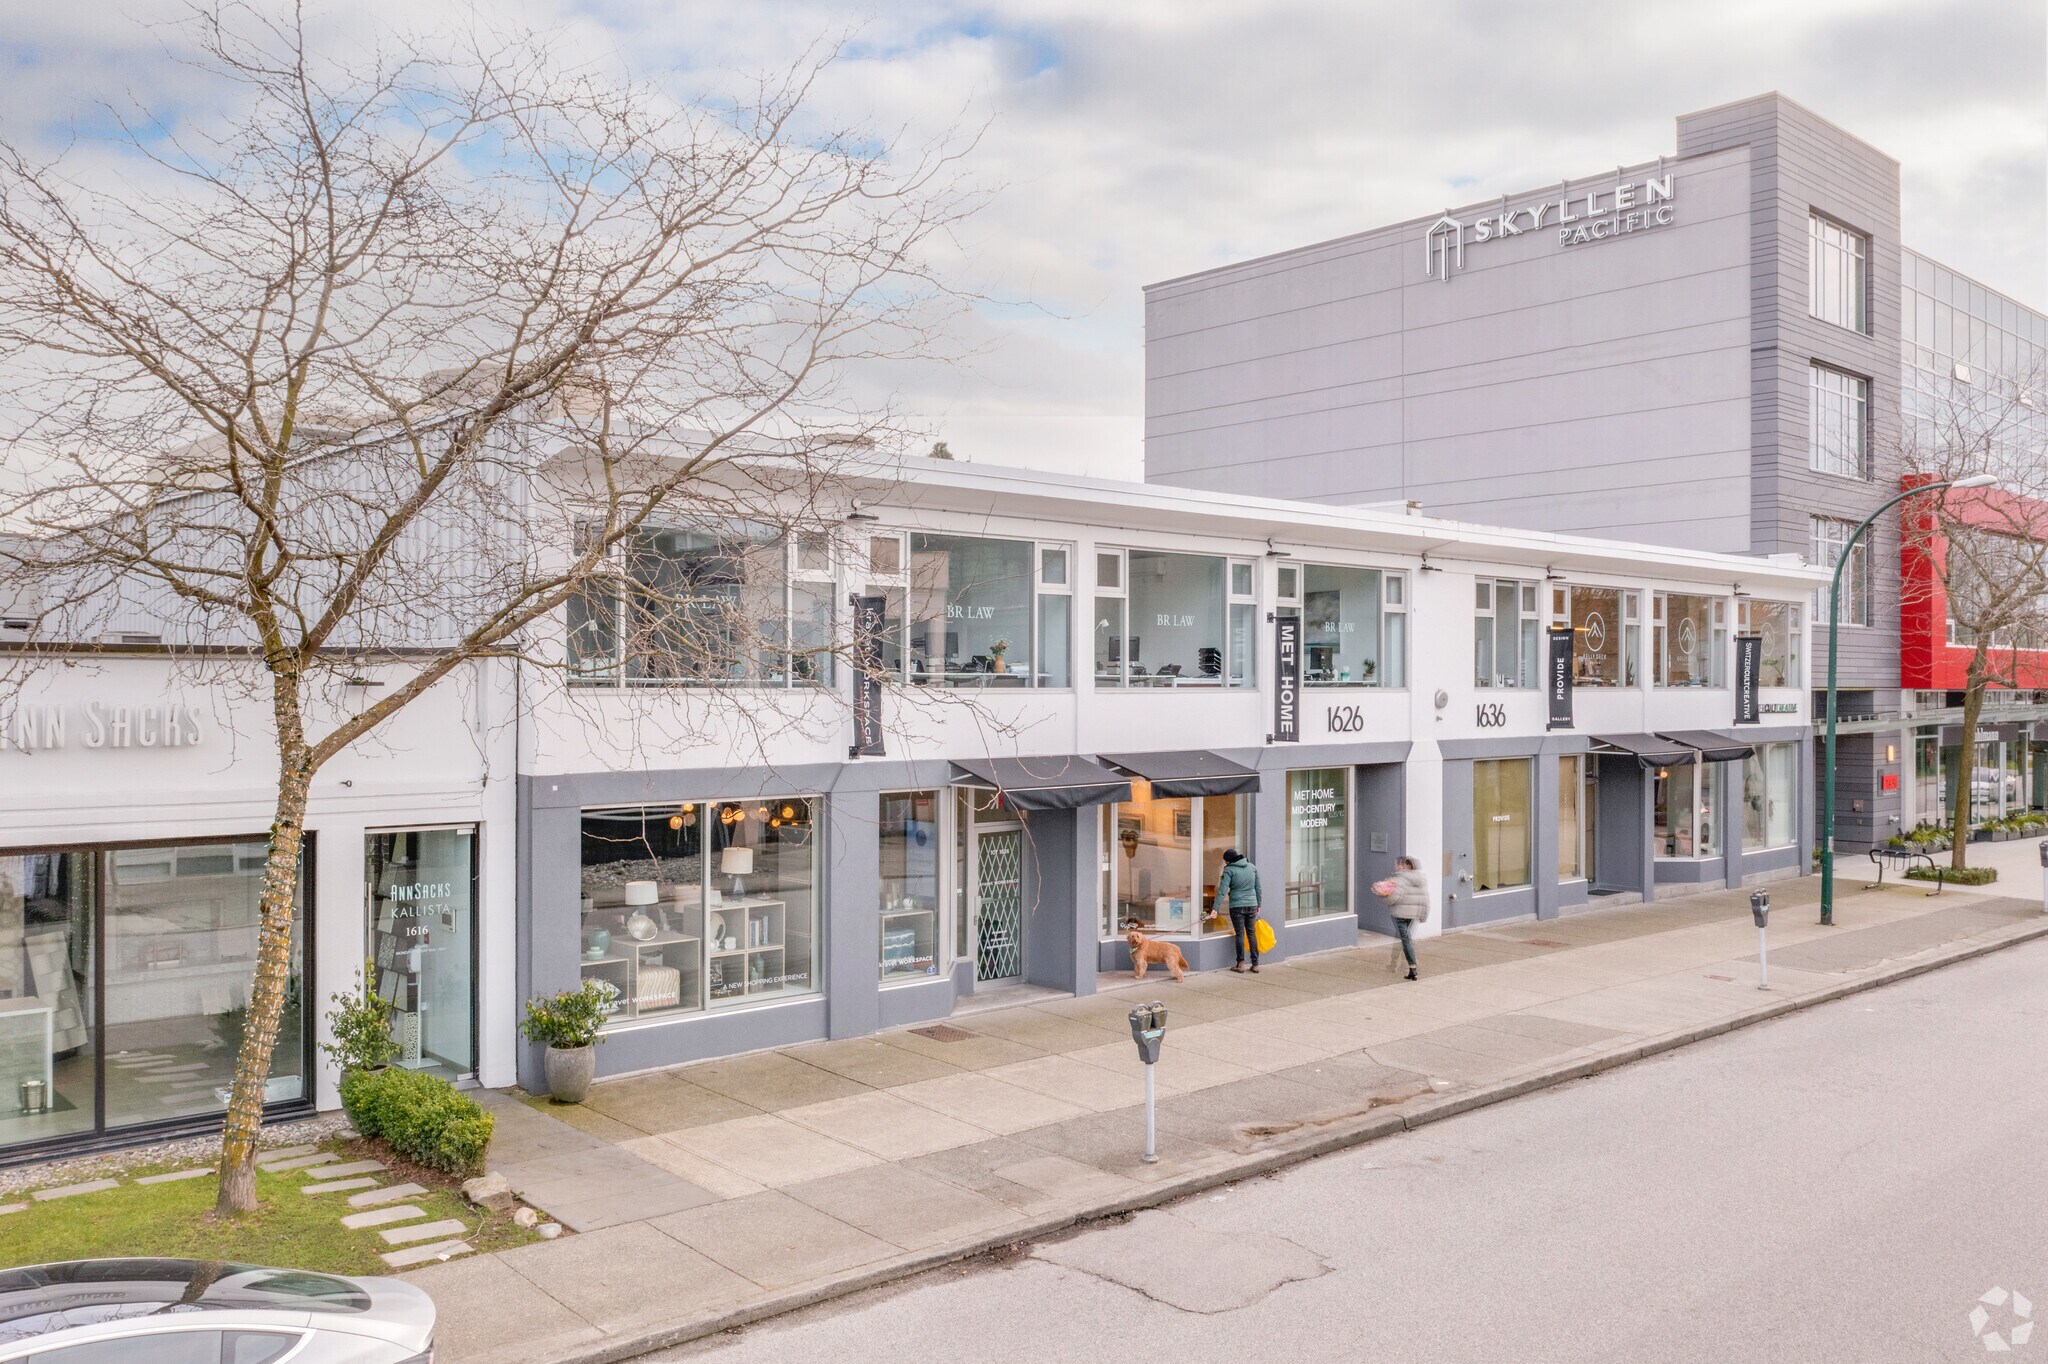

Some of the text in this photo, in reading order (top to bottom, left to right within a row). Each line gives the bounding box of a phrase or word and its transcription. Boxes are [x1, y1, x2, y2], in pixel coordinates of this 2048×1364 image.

[1474, 173, 1674, 243] SKYLLEN
[1559, 206, 1674, 247] PACIFIC
[947, 605, 995, 619] BR LAW
[1157, 614, 1196, 627] BR LAW
[1324, 621, 1356, 633] BR LAW
[1280, 625, 1294, 733] MET HOME
[1556, 657, 1565, 700] PROVIDE
[81, 697, 204, 748] SACKS
[1327, 705, 1364, 733] 1626
[1476, 703, 1506, 728] 1636
[1294, 788, 1334, 801] MET HOME
[1292, 803, 1336, 815] MID-CENTURY
[1300, 818, 1328, 828] MODERN
[391, 903, 451, 919] KALLISTA
[406, 925, 429, 937] 1616
[899, 955, 933, 966] WORKSPACE
[728, 981, 743, 989] NEW
[744, 977, 773, 987] SHOPPING
[773, 972, 808, 983] EXPERIENCE
